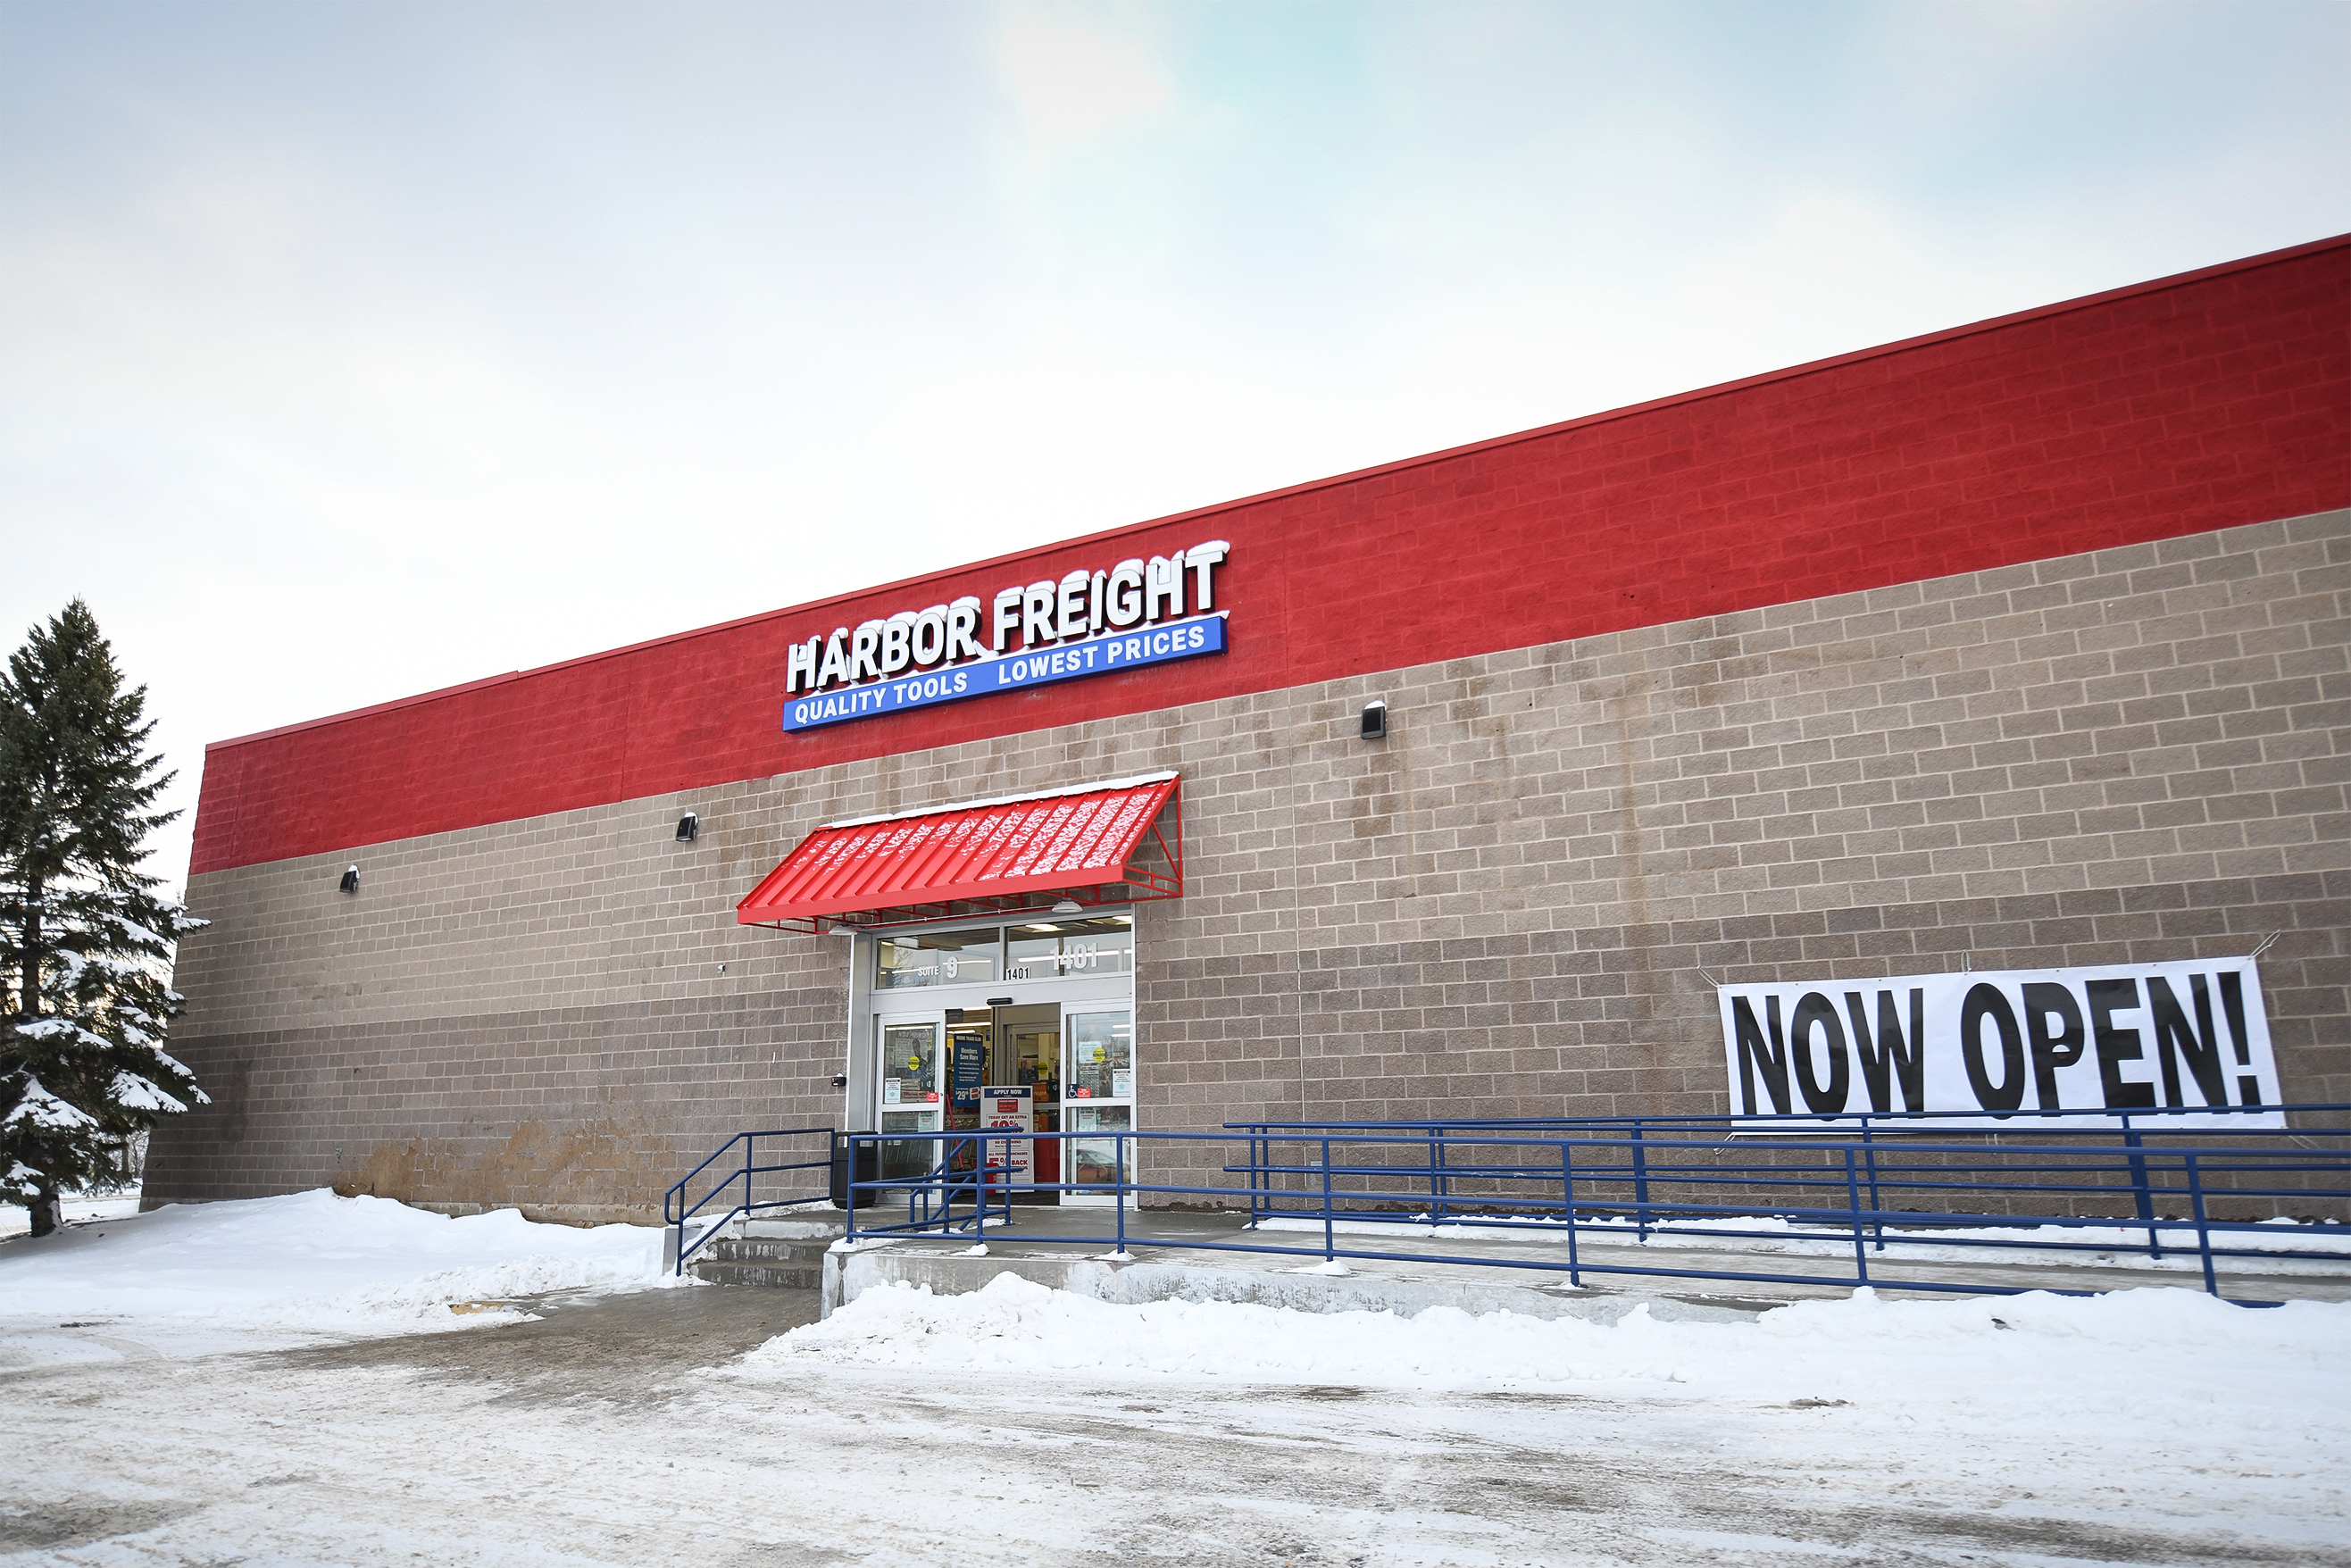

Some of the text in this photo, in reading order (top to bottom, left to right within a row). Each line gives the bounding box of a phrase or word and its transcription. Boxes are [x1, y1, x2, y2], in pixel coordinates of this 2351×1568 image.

[786, 549, 1224, 693] HARBOR FREIGHT
[795, 625, 1205, 725] QUALITY TOOLS LOWEST PRICES
[918, 955, 959, 980] SUITE 9
[1006, 966, 1030, 980] 1401
[1049, 942, 1098, 971] 1401
[1732, 971, 2262, 1122] NOW OPEN!
